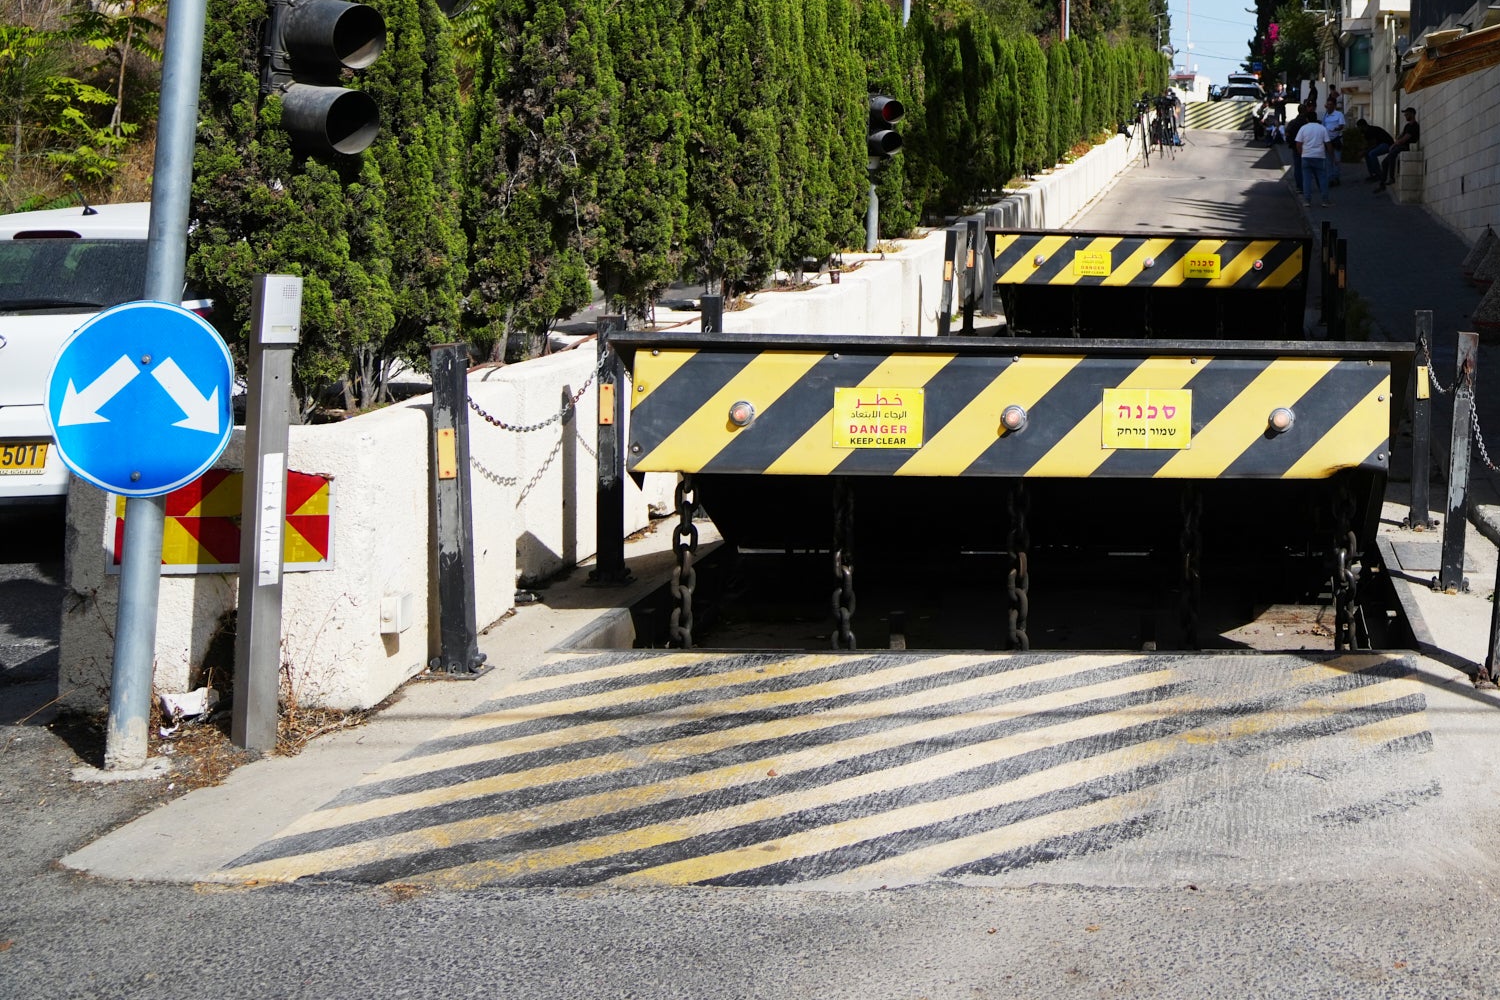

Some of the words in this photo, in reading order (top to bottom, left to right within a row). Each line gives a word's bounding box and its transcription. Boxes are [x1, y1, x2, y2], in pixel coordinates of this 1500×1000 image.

[855, 393, 902, 408] خطر
[1118, 404, 1176, 420] סכנה
[849, 424, 907, 434] DANGER
[1117, 428, 1146, 437] מרחק
[1150, 428, 1176, 436] שמור
[850, 437, 874, 445] KEEP
[875, 437, 906, 445] CLEAR
[2, 445, 38, 466] 501
